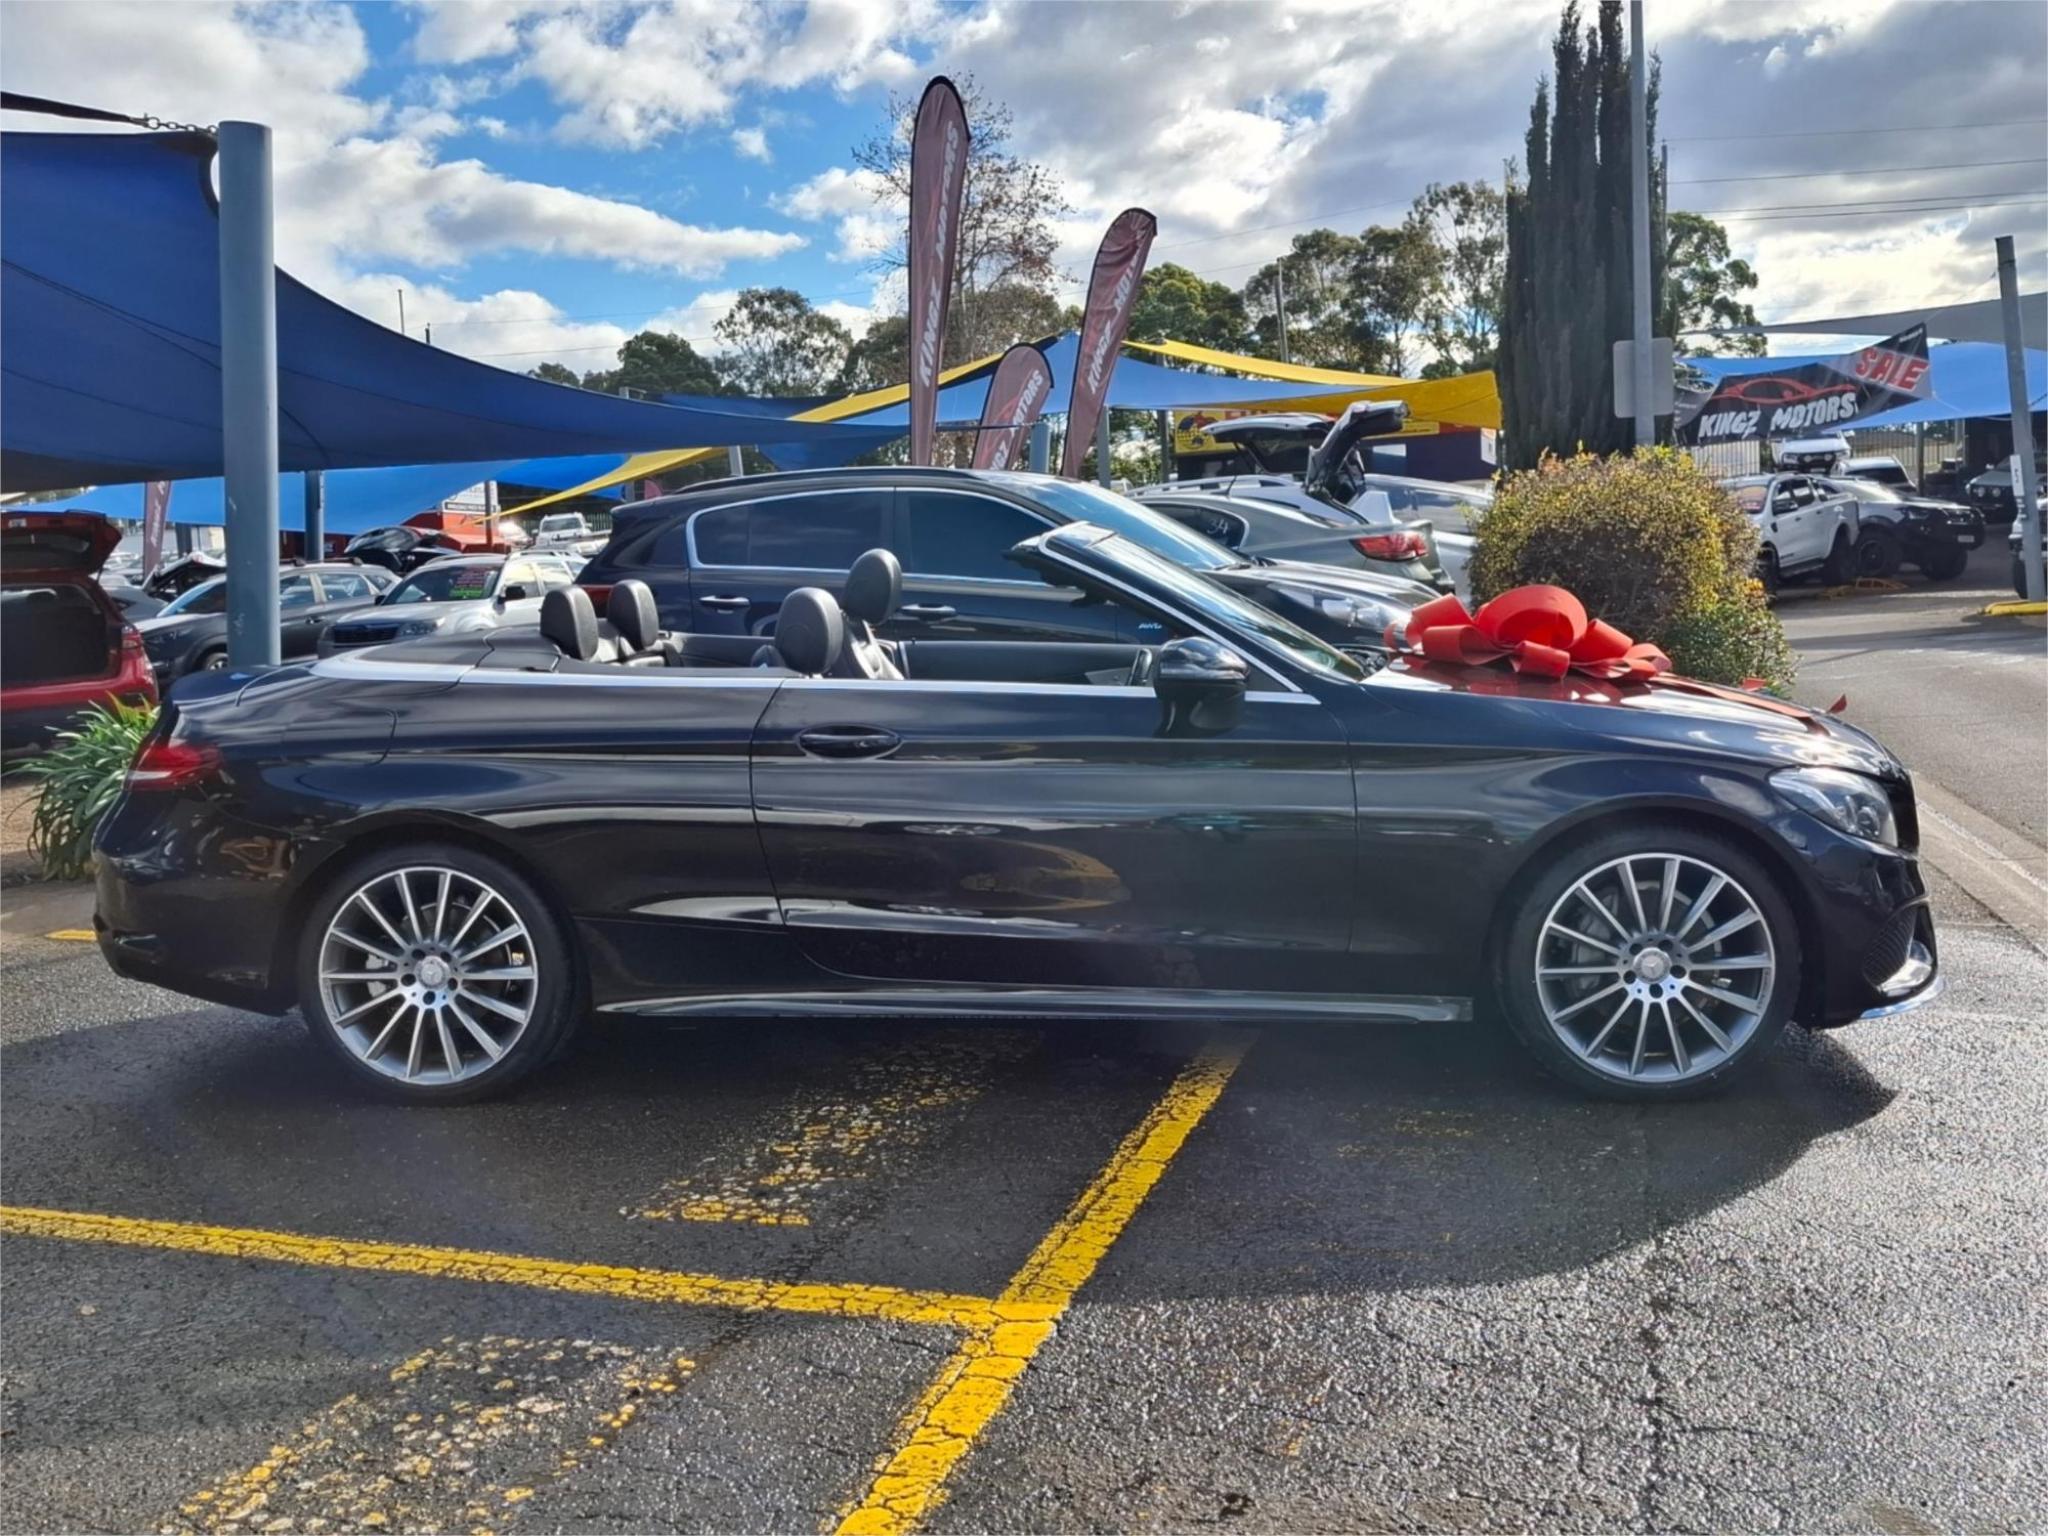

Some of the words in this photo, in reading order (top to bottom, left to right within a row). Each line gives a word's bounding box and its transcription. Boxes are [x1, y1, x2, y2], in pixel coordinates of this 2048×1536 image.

[919, 286, 941, 388] KINGZ
[1855, 346, 1927, 390] SALE
[1699, 410, 1760, 438] KINGZ
[1770, 392, 1856, 429] MOTORS
